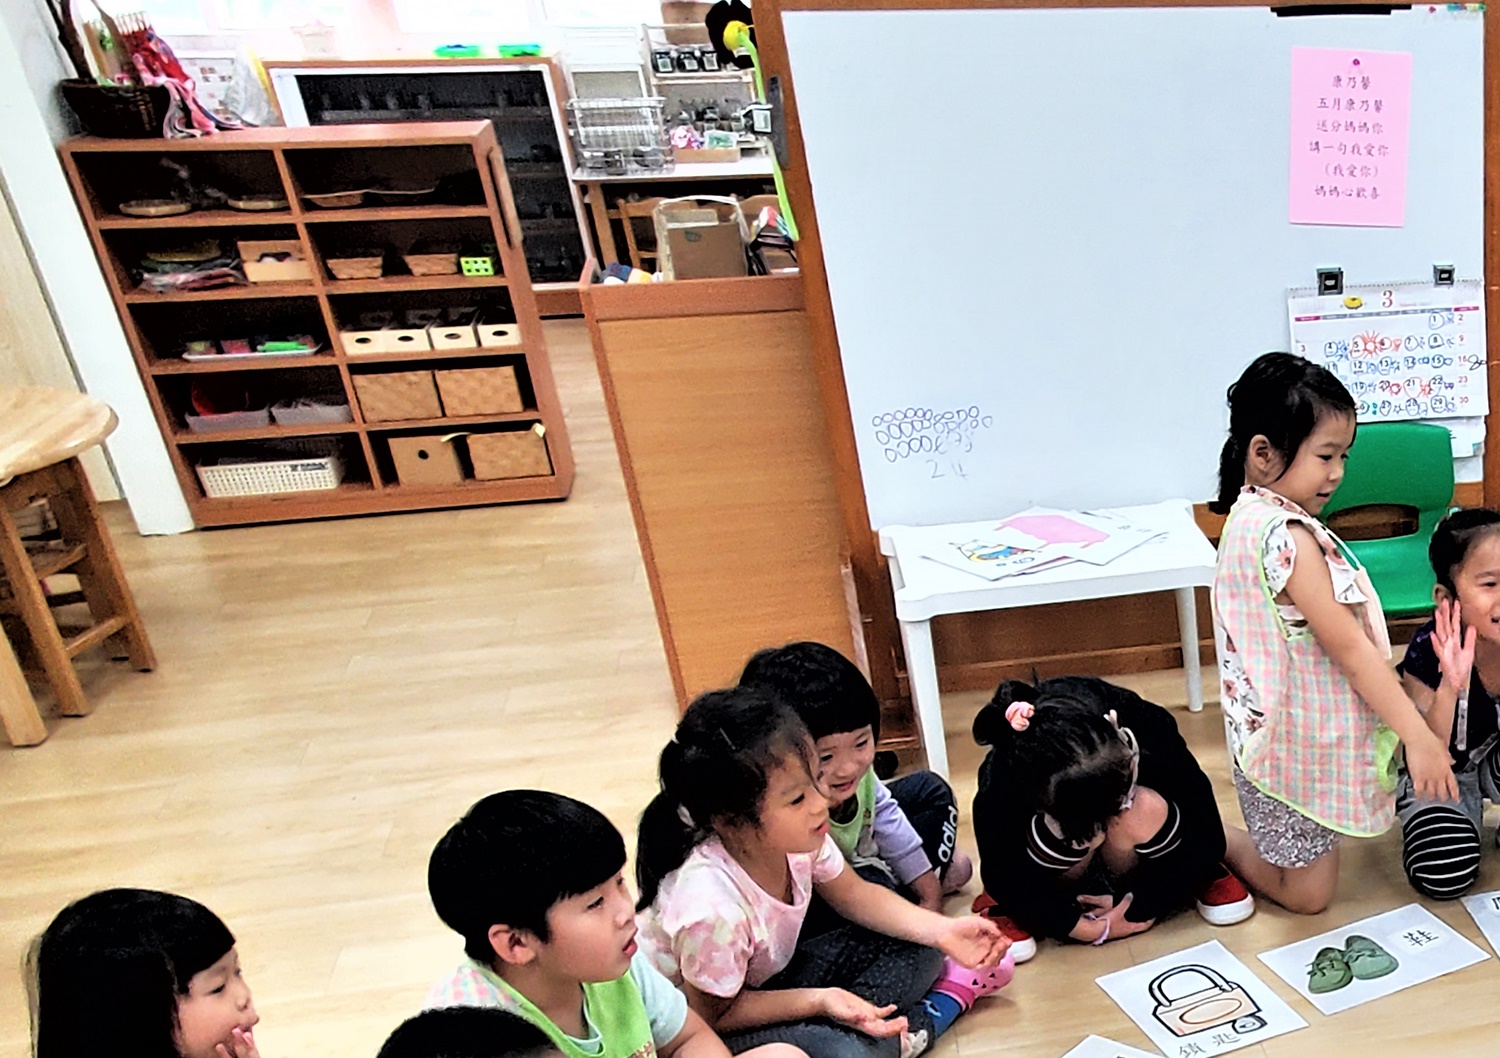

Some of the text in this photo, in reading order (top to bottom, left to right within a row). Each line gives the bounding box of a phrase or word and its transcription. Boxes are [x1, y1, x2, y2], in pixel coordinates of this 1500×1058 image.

[1332, 75, 1371, 90] 康乃馨
[1317, 98, 1384, 113] 五月康乃馨
[1309, 141, 1390, 157] 講一句我愛你
[1315, 185, 1380, 200] 媽媽心歡喜
[1382, 290, 1394, 308] 3
[1402, 928, 1441, 948] 鞋
